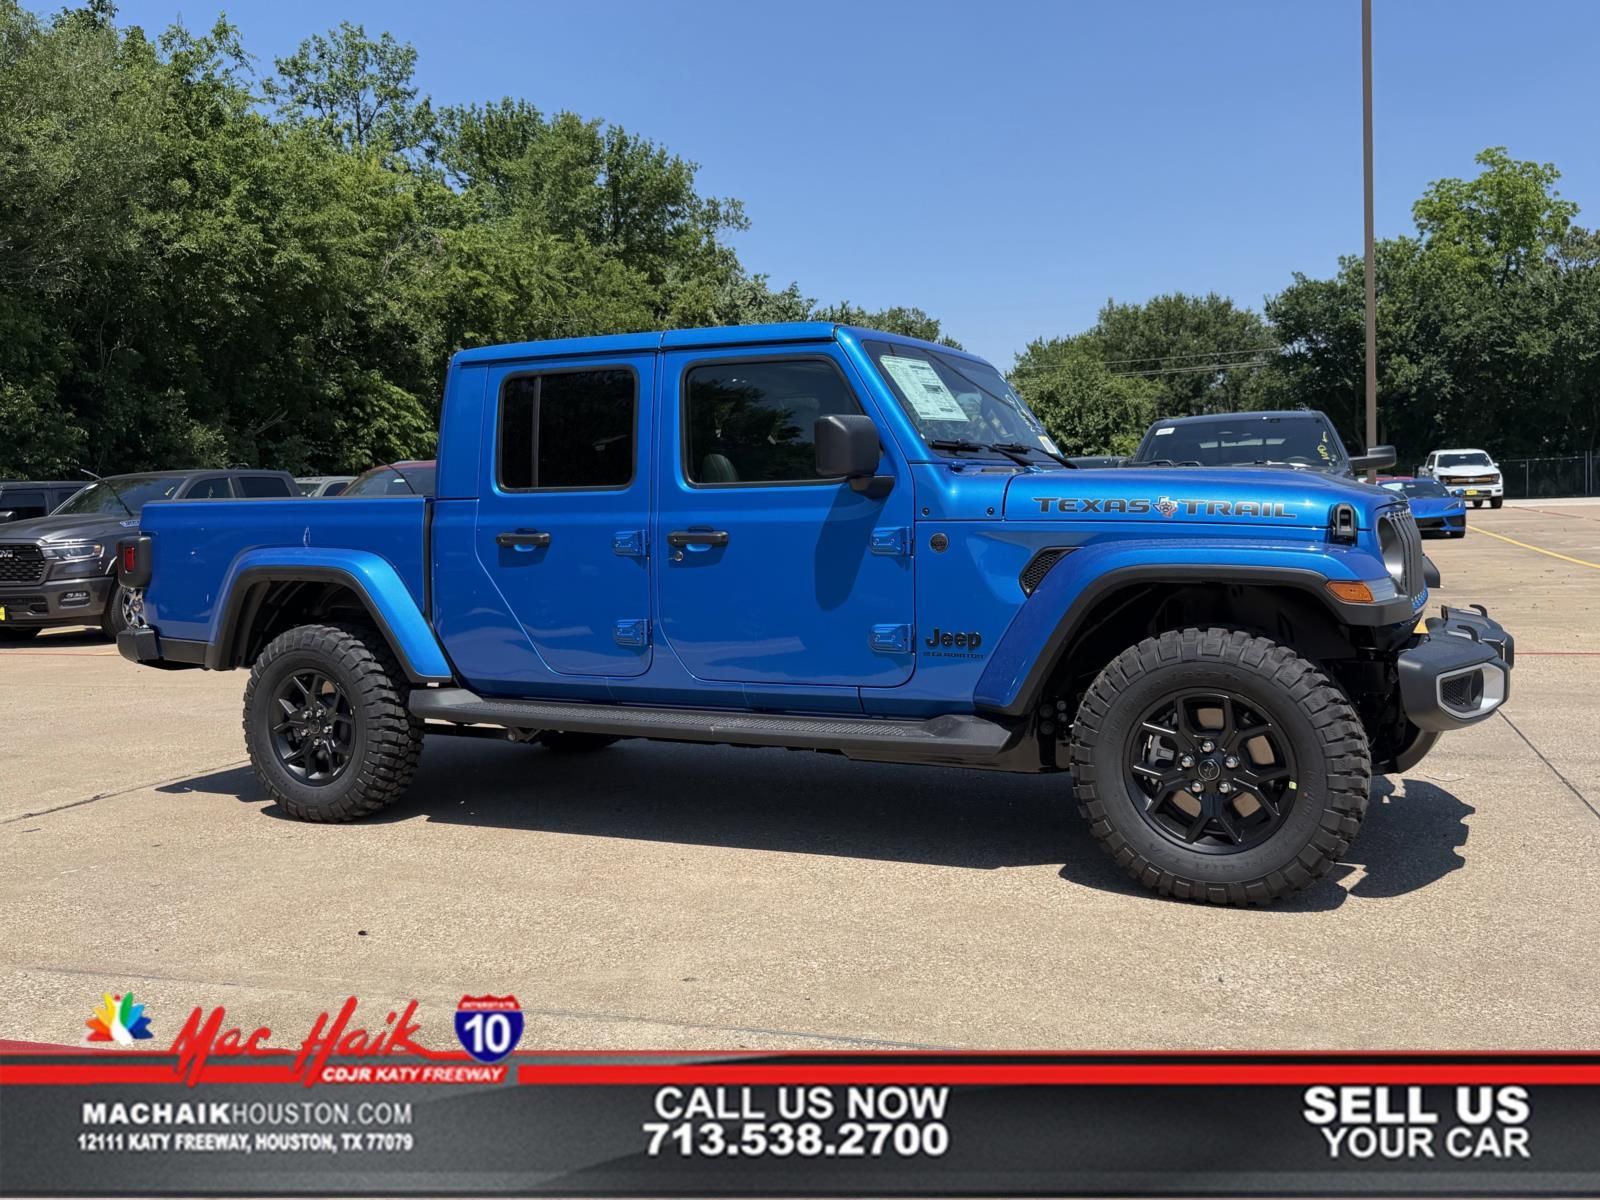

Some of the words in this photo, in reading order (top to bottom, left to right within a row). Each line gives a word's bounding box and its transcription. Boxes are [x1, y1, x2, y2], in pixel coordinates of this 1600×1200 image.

[1032, 497, 1150, 513] TEXAS
[1177, 499, 1297, 519] TRAIL
[925, 627, 982, 651] Jeep
